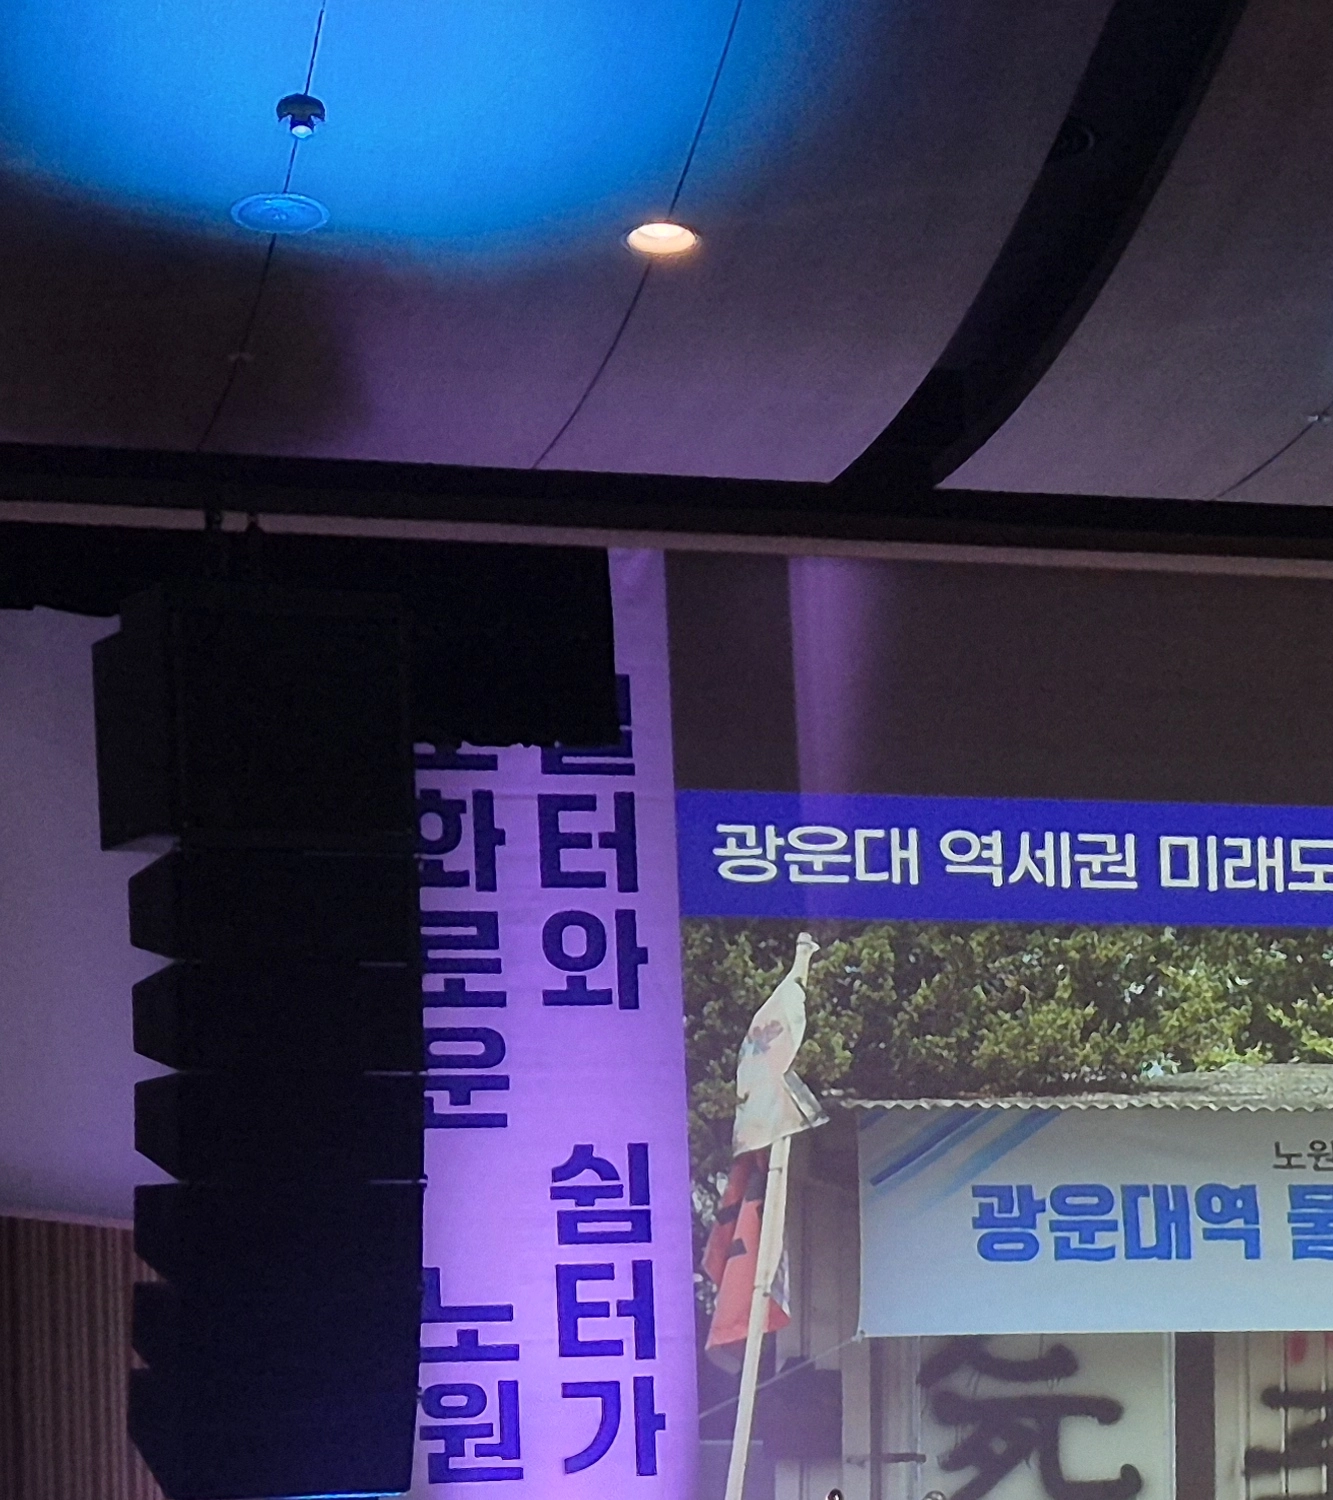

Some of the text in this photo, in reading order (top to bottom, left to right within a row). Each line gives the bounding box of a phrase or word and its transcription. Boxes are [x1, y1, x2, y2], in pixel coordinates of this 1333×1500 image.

[711, 822, 920, 887] 광운대
[939, 829, 1138, 891] 역세권
[413, 742, 523, 1484] 화로운 노원
[536, 672, 666, 1476] 터와 쉼터가
[970, 1181, 1261, 1262] 광운대역
